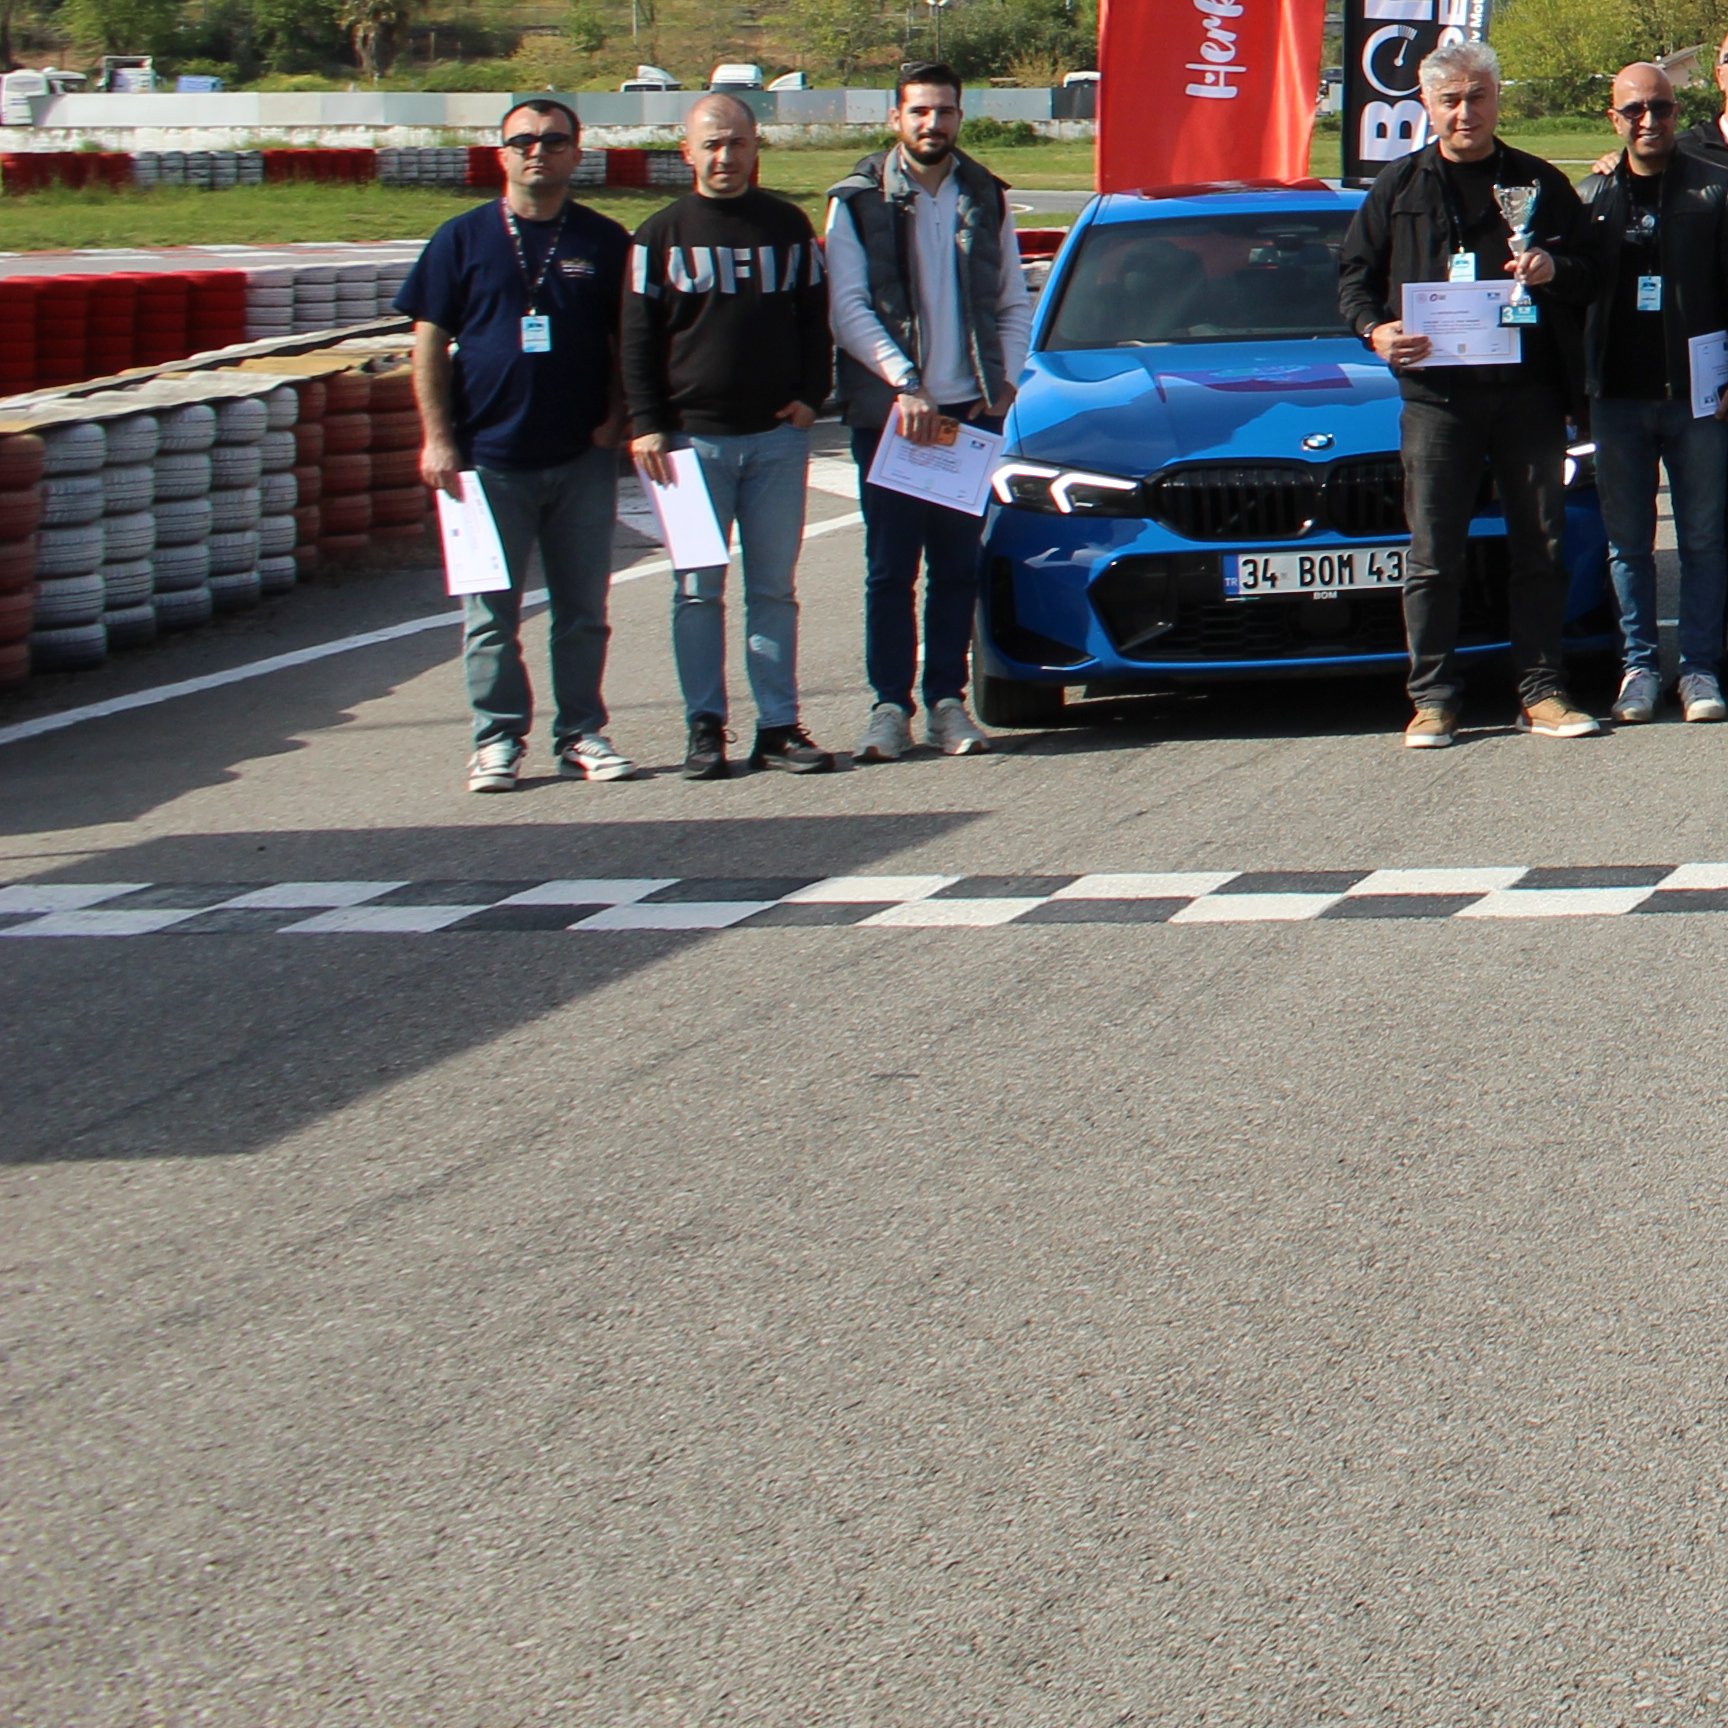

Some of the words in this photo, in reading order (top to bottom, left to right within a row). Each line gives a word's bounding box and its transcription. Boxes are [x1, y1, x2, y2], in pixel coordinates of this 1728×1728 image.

[1242, 558, 1279, 589] 34
[1299, 553, 1356, 587] BOM
[1367, 551, 1411, 582] 43
[1224, 577, 1239, 587] TR
[1313, 591, 1338, 600] BOM
